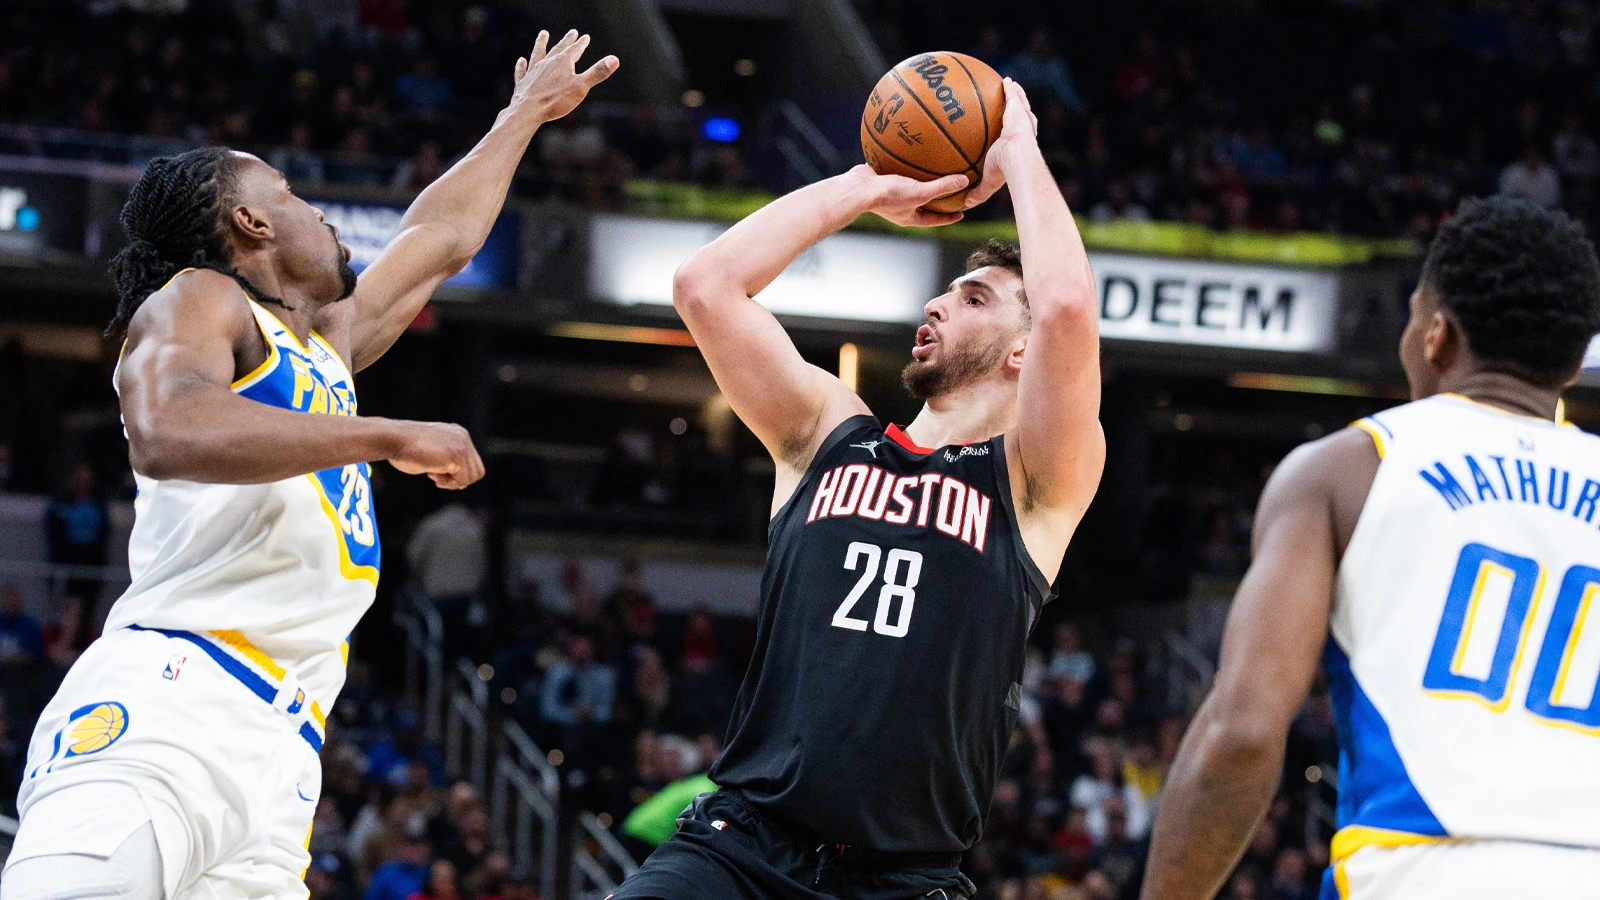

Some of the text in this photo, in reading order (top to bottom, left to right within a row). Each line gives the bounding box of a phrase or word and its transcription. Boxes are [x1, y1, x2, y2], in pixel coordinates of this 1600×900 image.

[1101, 276, 1296, 333] DEEM
[337, 463, 375, 547] 23
[806, 463, 992, 554] HOUSTON
[1419, 454, 1600, 530] MATHUR
[831, 541, 923, 638] 28
[1421, 542, 1600, 738] 00
